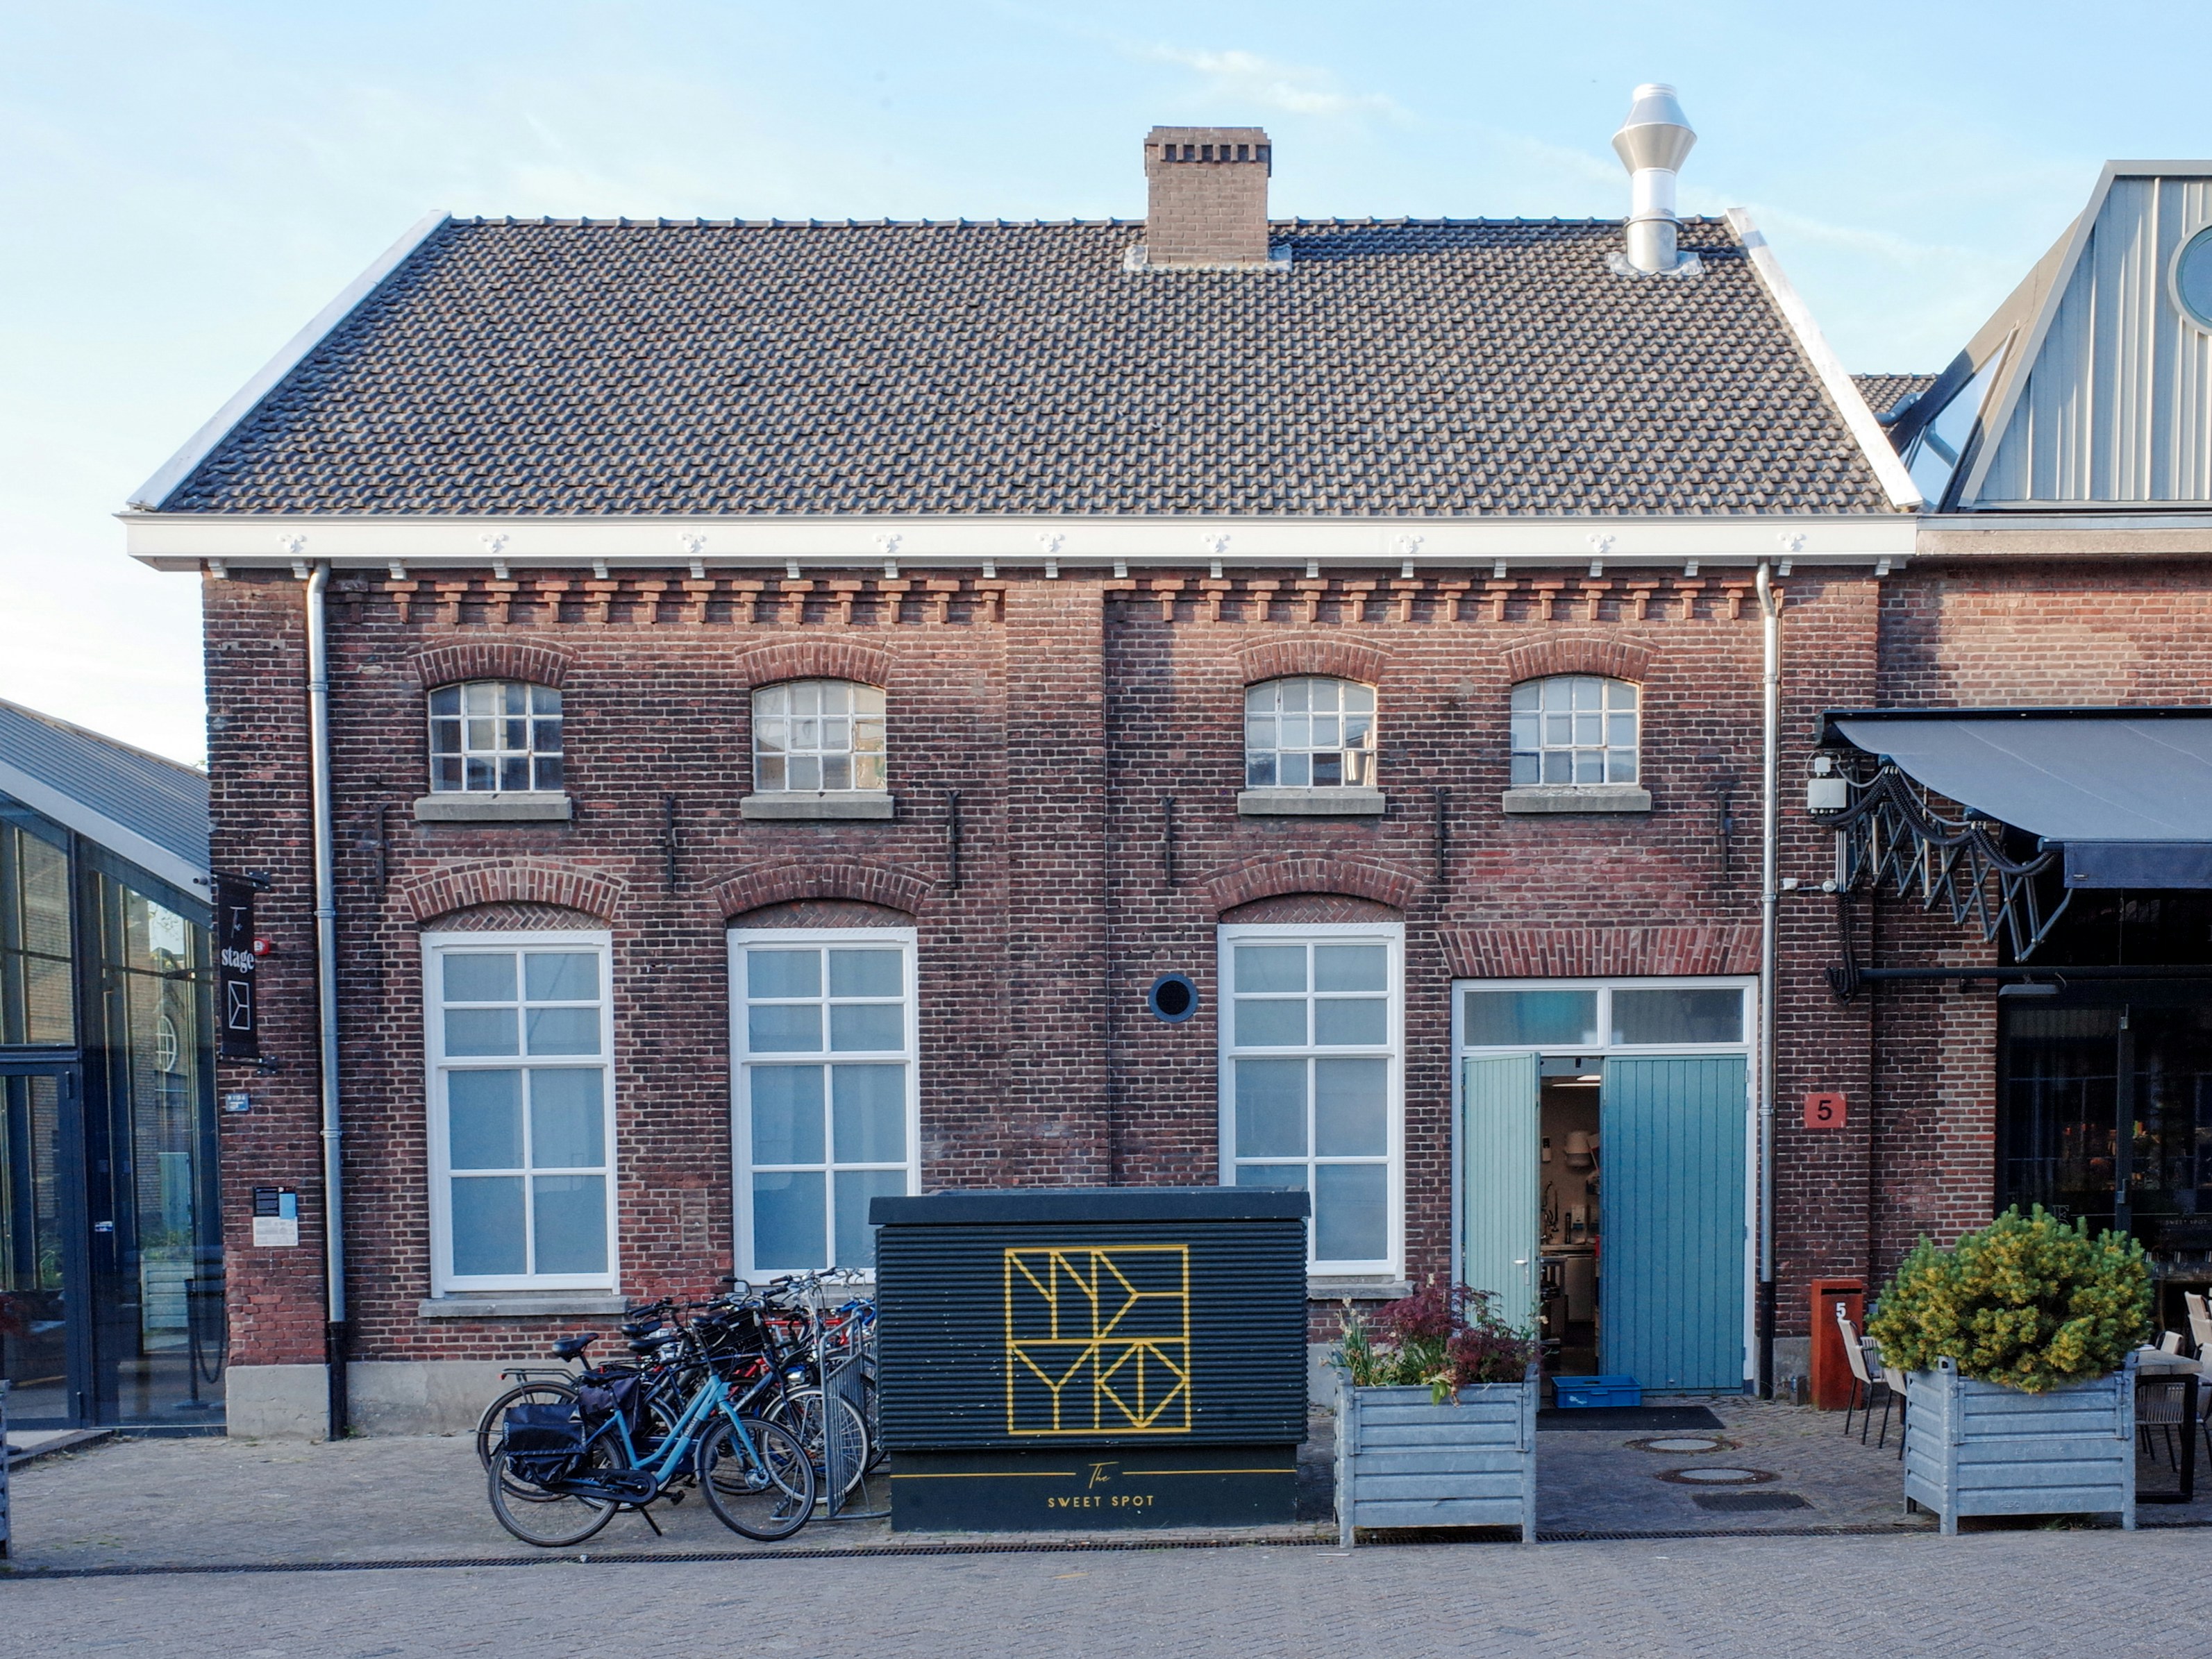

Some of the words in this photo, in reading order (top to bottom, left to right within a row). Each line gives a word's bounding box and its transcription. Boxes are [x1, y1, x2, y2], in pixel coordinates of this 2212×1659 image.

[221, 946, 255, 974] stage
[1818, 1100, 1832, 1121] 5
[1836, 1302, 1846, 1317] 5
[1088, 1461, 1120, 1489] The
[1048, 1496, 1101, 1508] SWEET
[1112, 1495, 1154, 1507] SPOT
